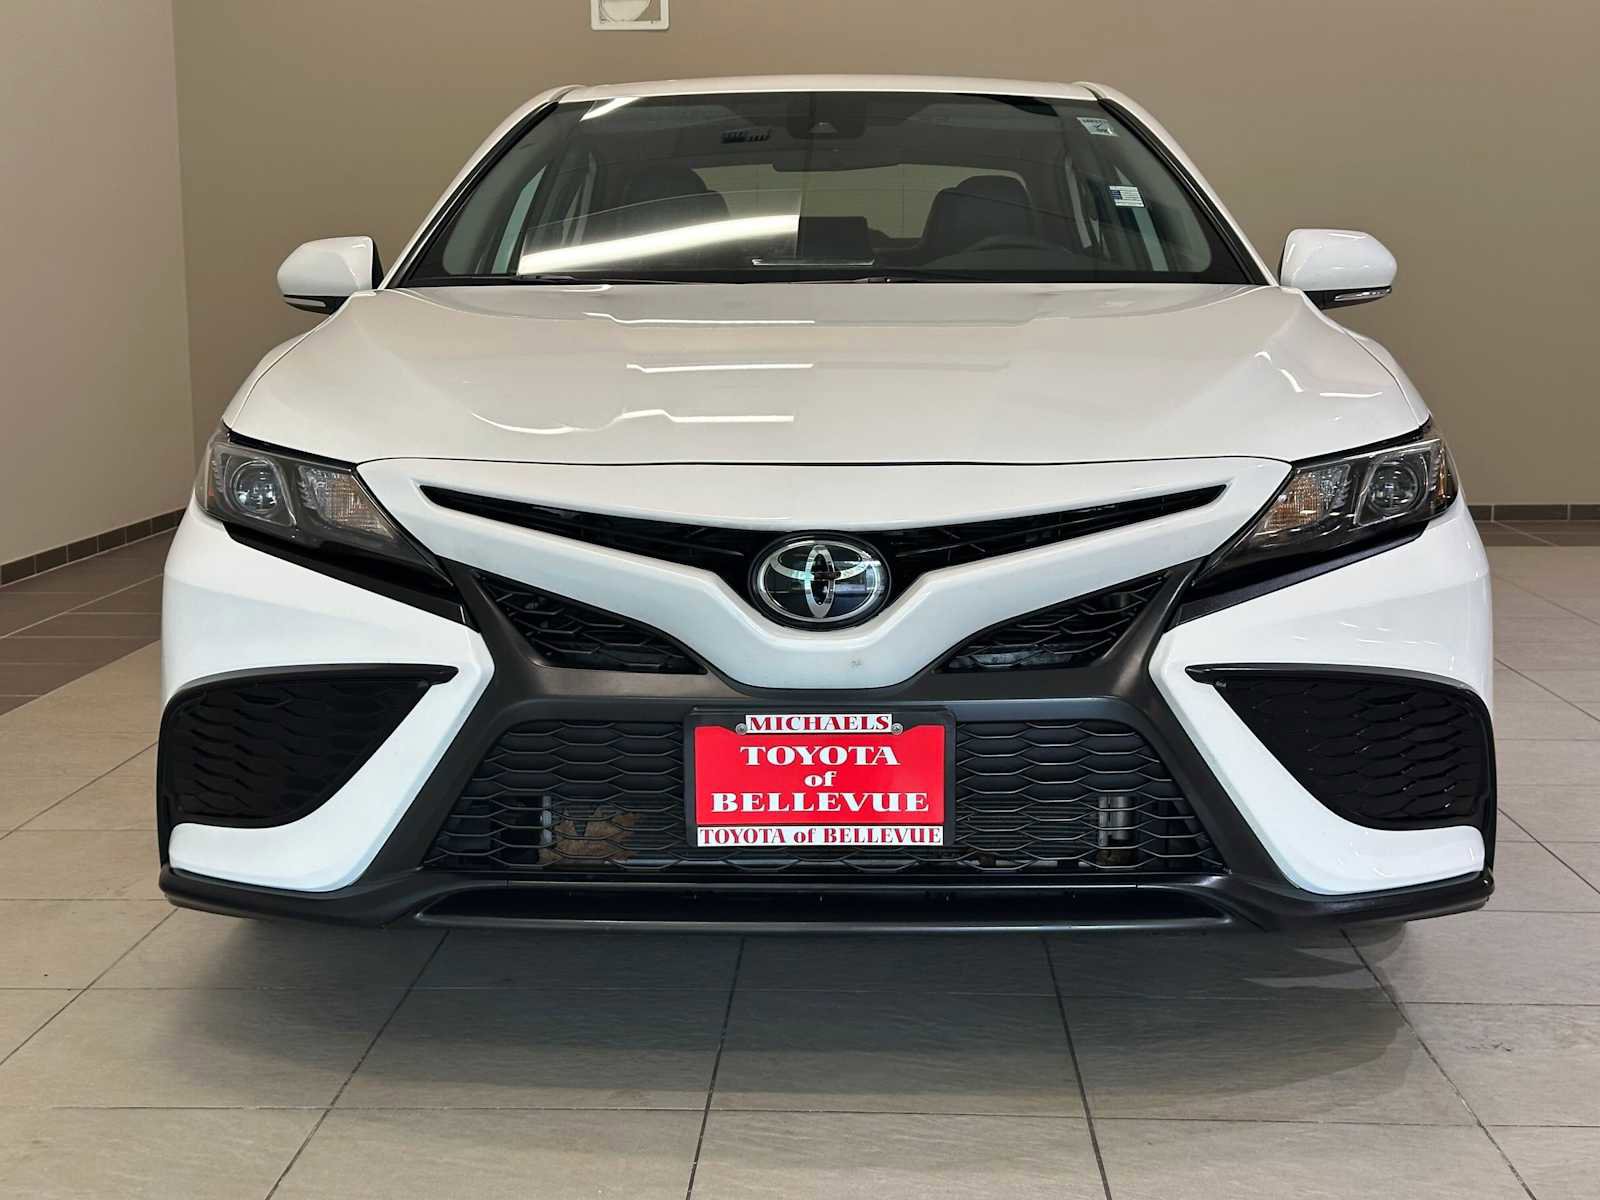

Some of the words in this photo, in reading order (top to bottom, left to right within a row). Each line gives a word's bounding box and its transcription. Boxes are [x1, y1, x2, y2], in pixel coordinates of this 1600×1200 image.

[750, 716, 890, 731] MICHAELS
[740, 746, 901, 766] TOYOTA
[804, 771, 837, 787] of
[711, 792, 929, 812] BELLEVUE
[700, 828, 787, 844] TOYOTA
[793, 828, 816, 844] of
[823, 828, 942, 844] BELLEVUE
